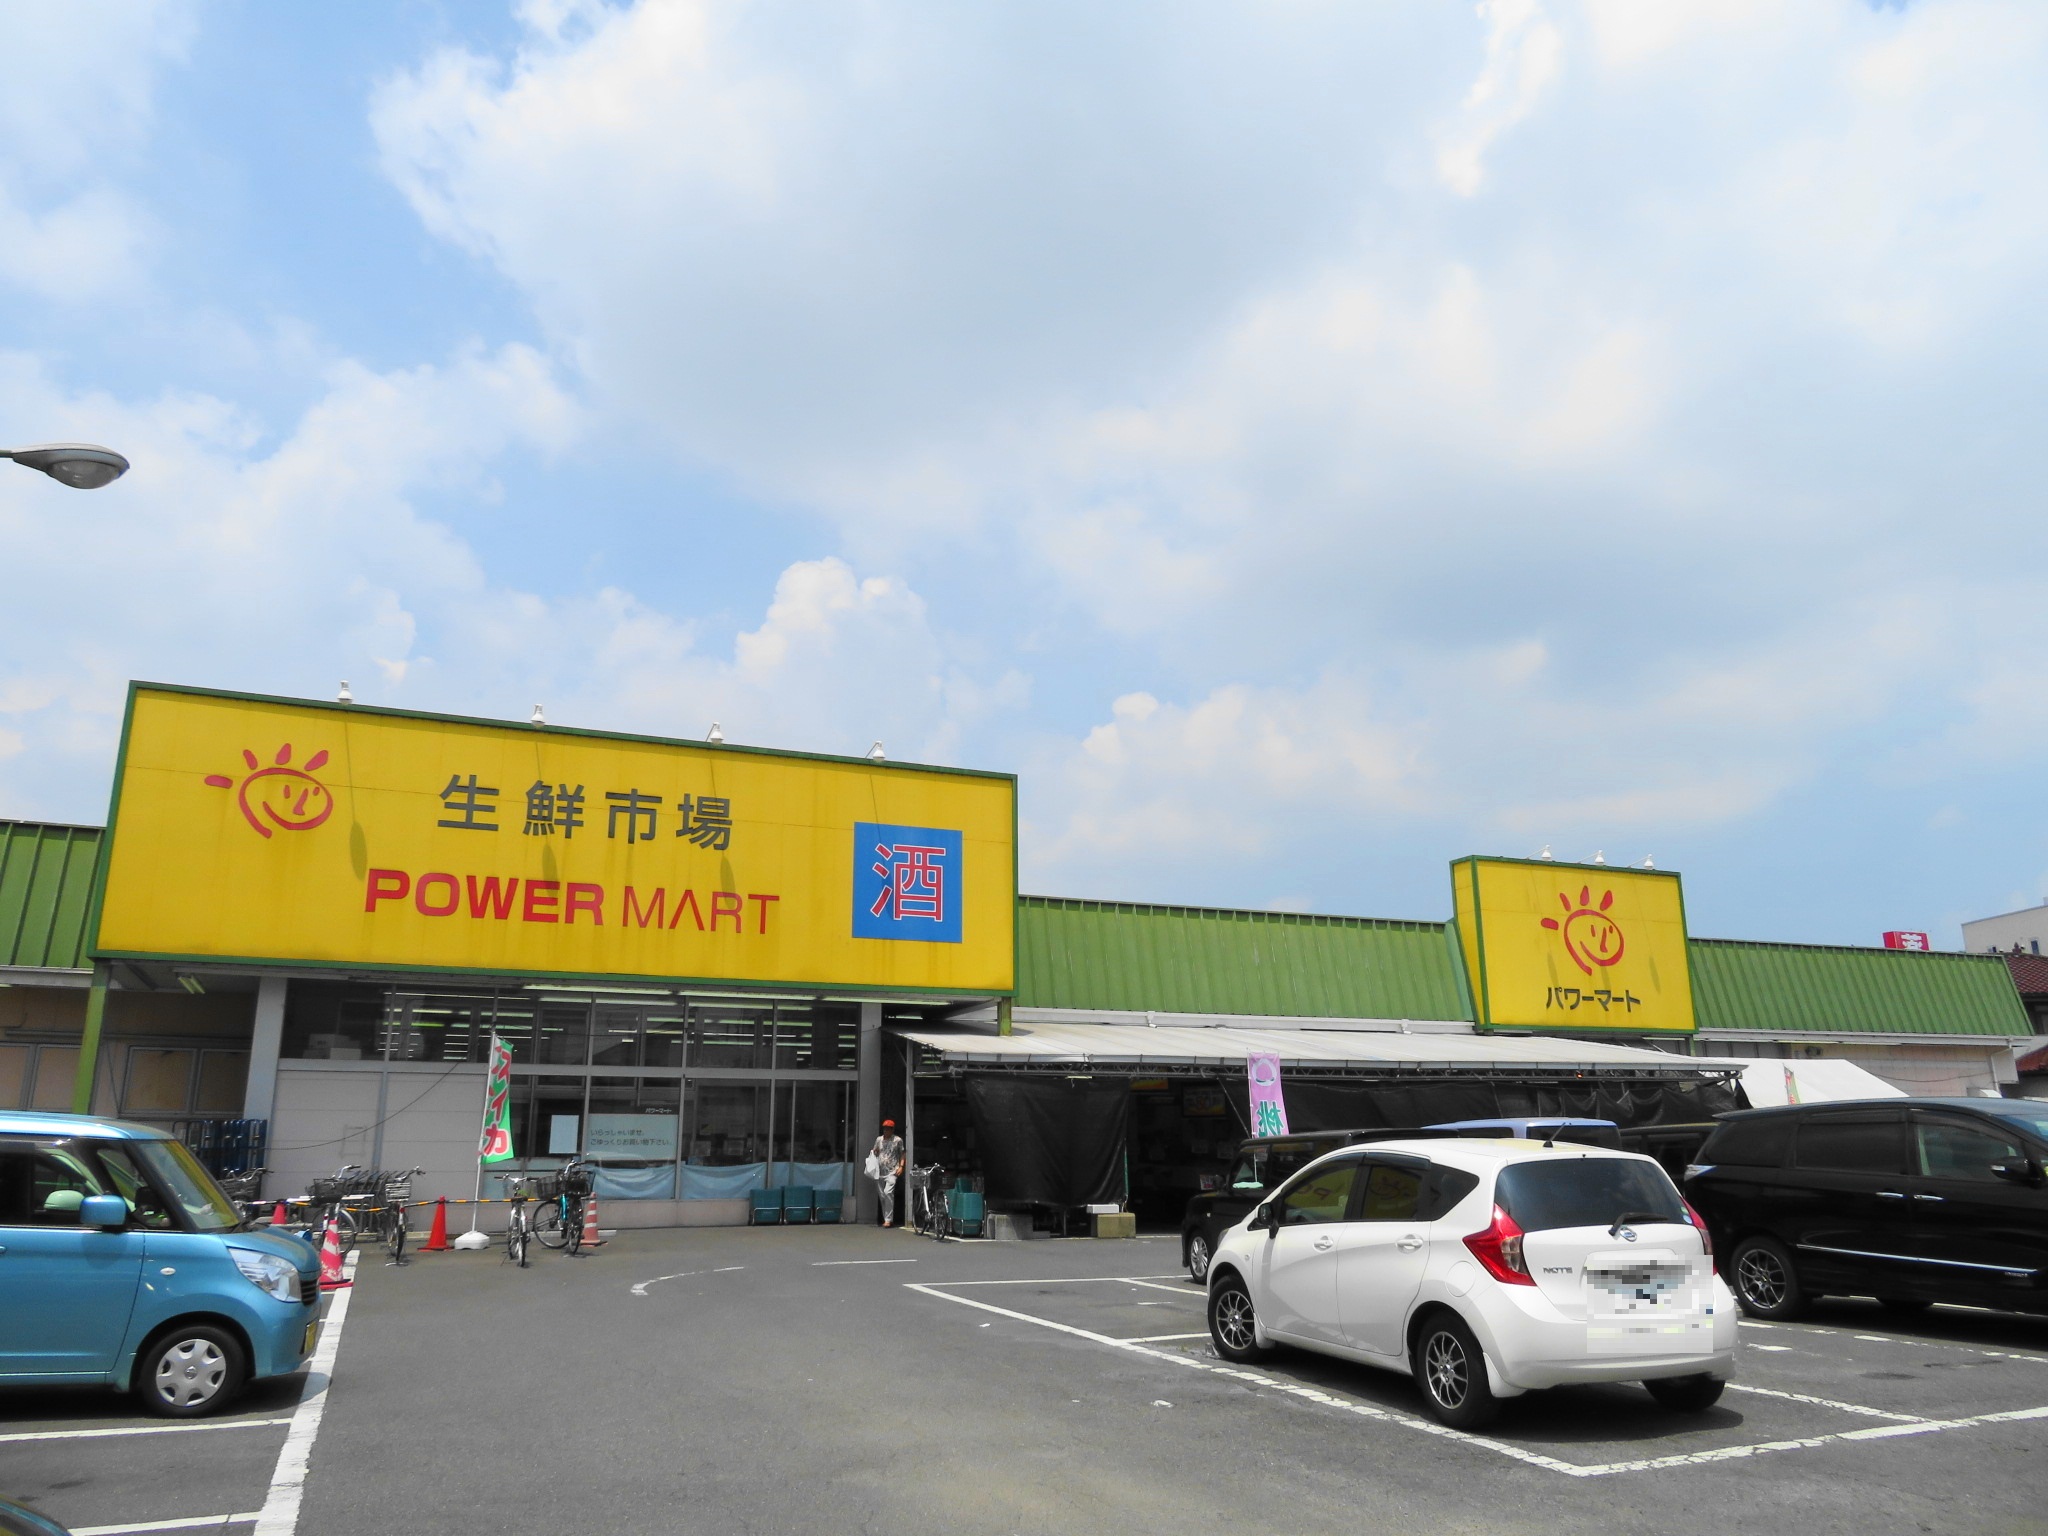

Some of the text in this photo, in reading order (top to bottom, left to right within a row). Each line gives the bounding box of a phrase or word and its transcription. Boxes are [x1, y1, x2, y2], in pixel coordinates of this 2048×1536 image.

[437, 774, 734, 852] 生鮮市場
[364, 867, 781, 936] POWER MART
[869, 841, 947, 923] 酒
[1545, 985, 1641, 1013] パワーマート
[482, 1045, 512, 1156] スイカ
[1543, 1266, 1573, 1275] NOTE
